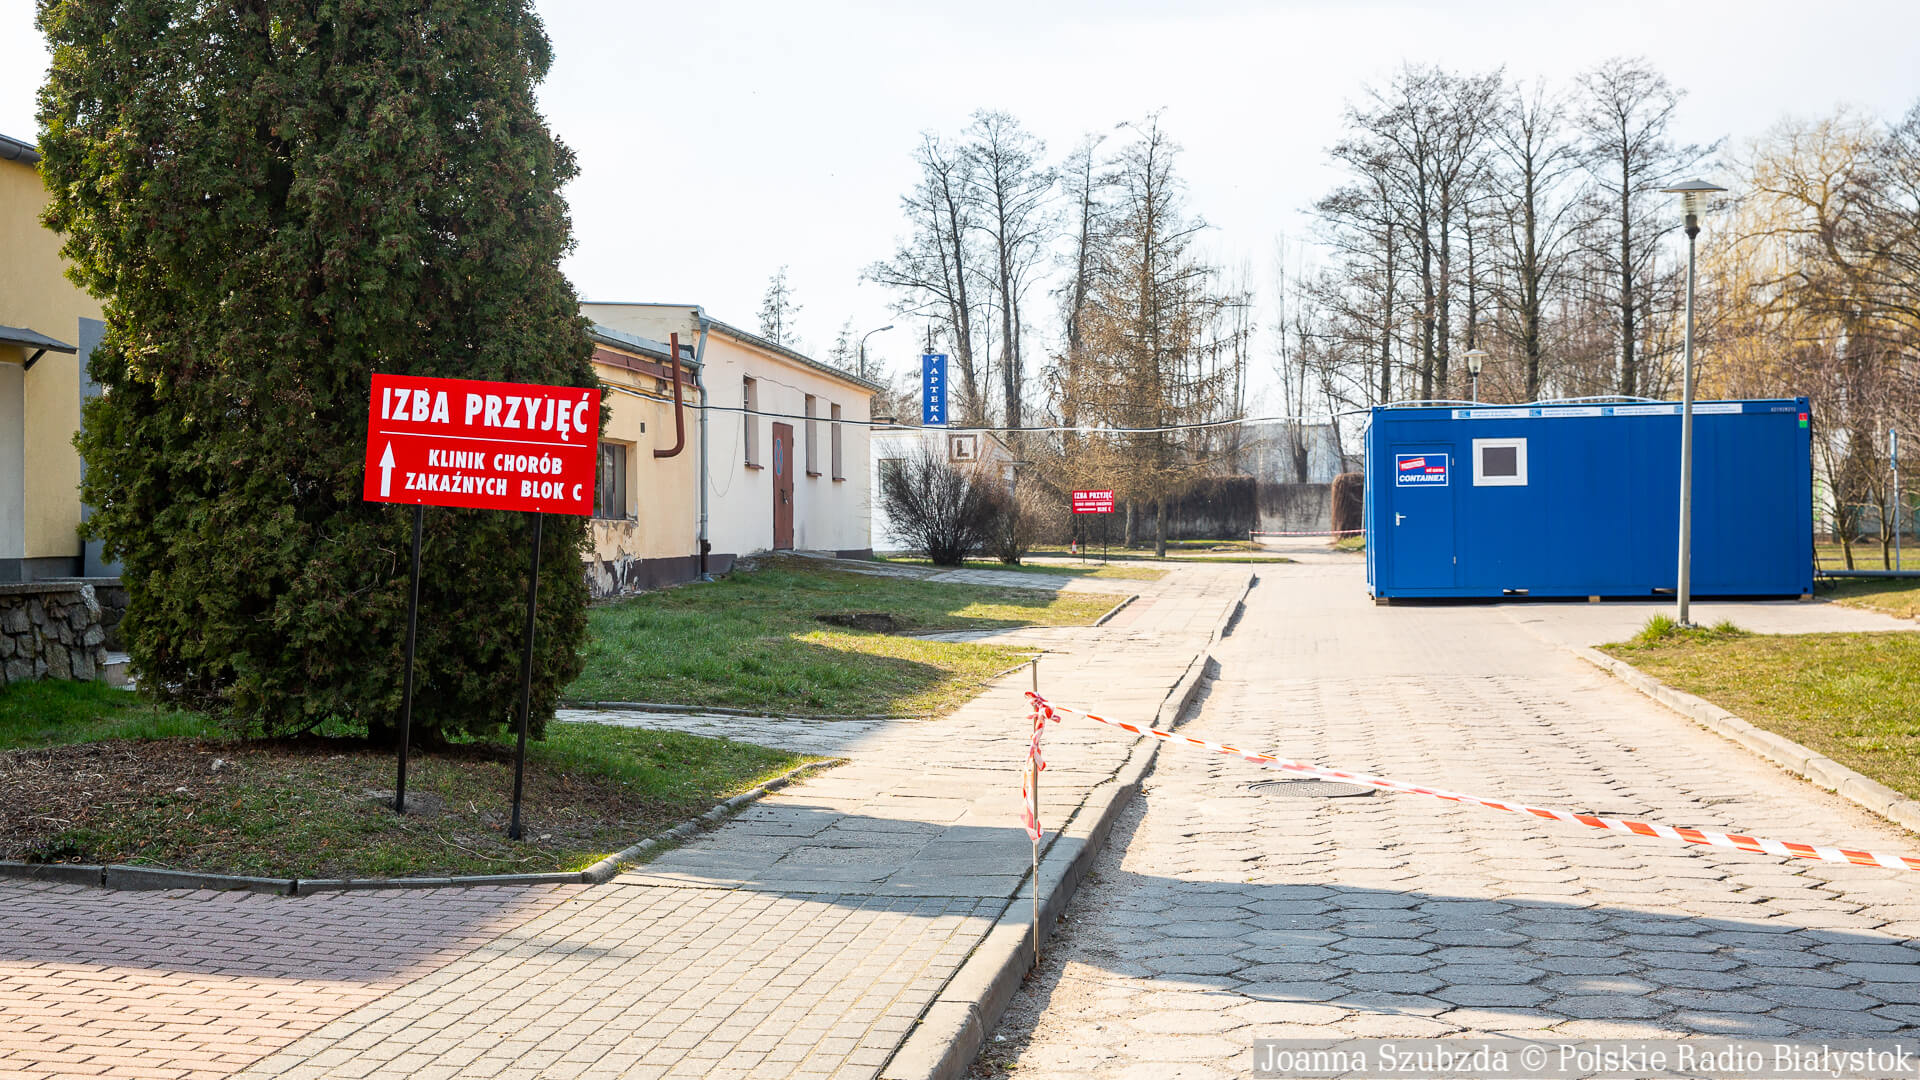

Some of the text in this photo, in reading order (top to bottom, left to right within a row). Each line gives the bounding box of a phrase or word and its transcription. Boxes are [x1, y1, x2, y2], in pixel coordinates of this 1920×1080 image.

[930, 367, 939, 422] APTEKA
[381, 387, 590, 441] IZBA PRZYJĘĆ
[428, 449, 563, 475] KLINIK CHORÓB
[404, 471, 583, 501] ZAKAŹNYCH BLOK C
[1399, 474, 1446, 482] CONTAINEX
